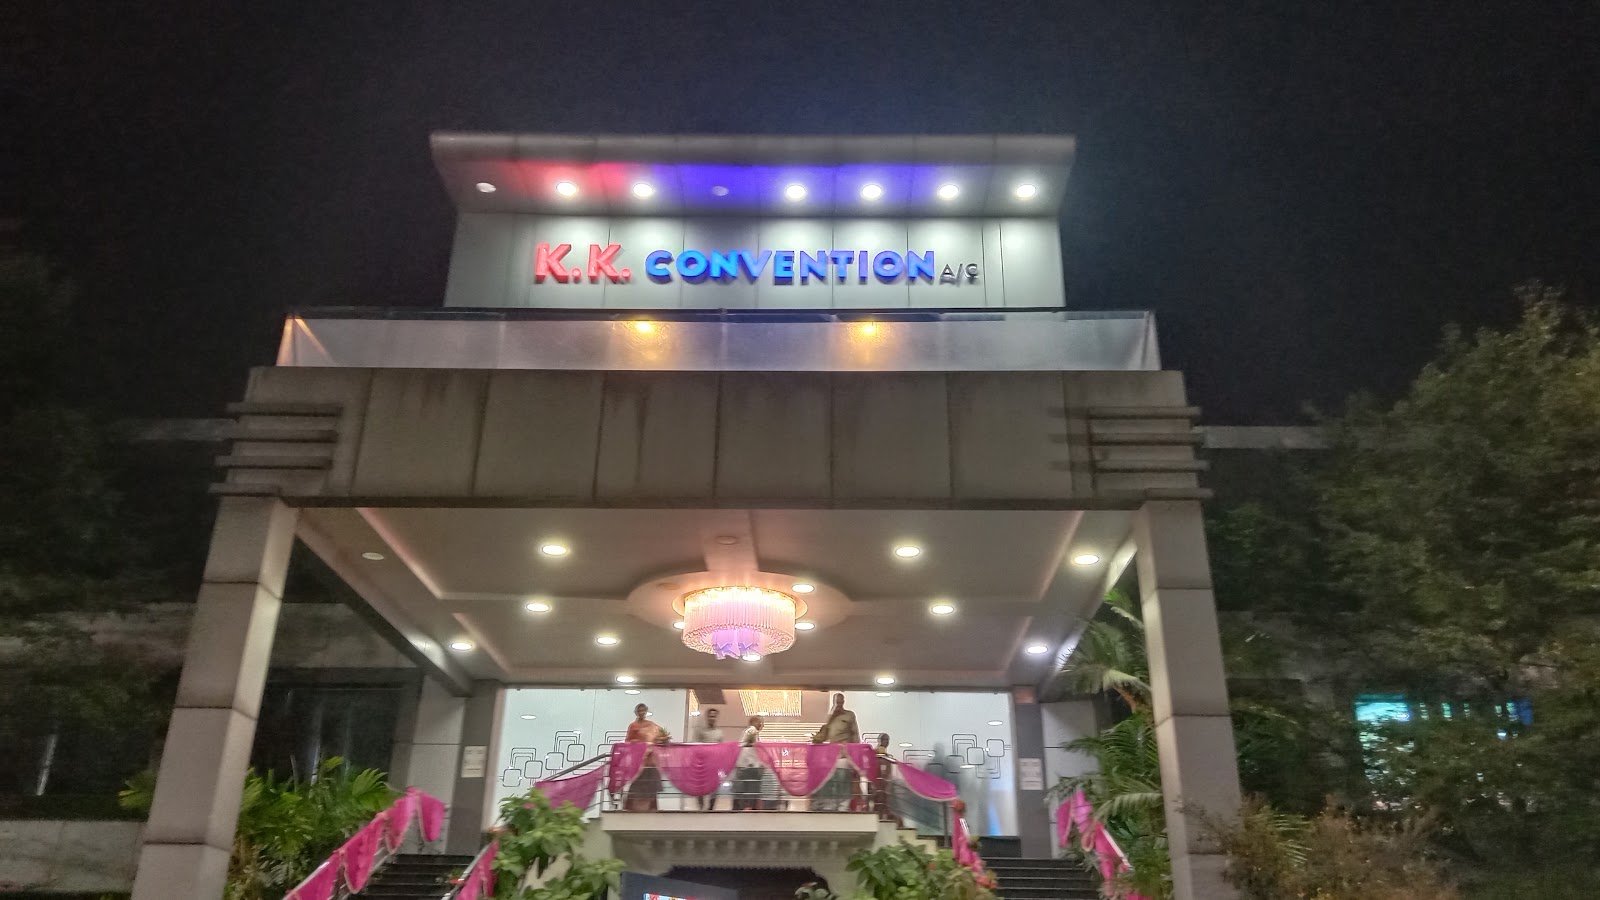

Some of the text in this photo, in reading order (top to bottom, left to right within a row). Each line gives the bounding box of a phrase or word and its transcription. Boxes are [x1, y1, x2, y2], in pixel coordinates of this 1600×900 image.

[535, 243, 979, 286] K.K. CONVENTION A/C
